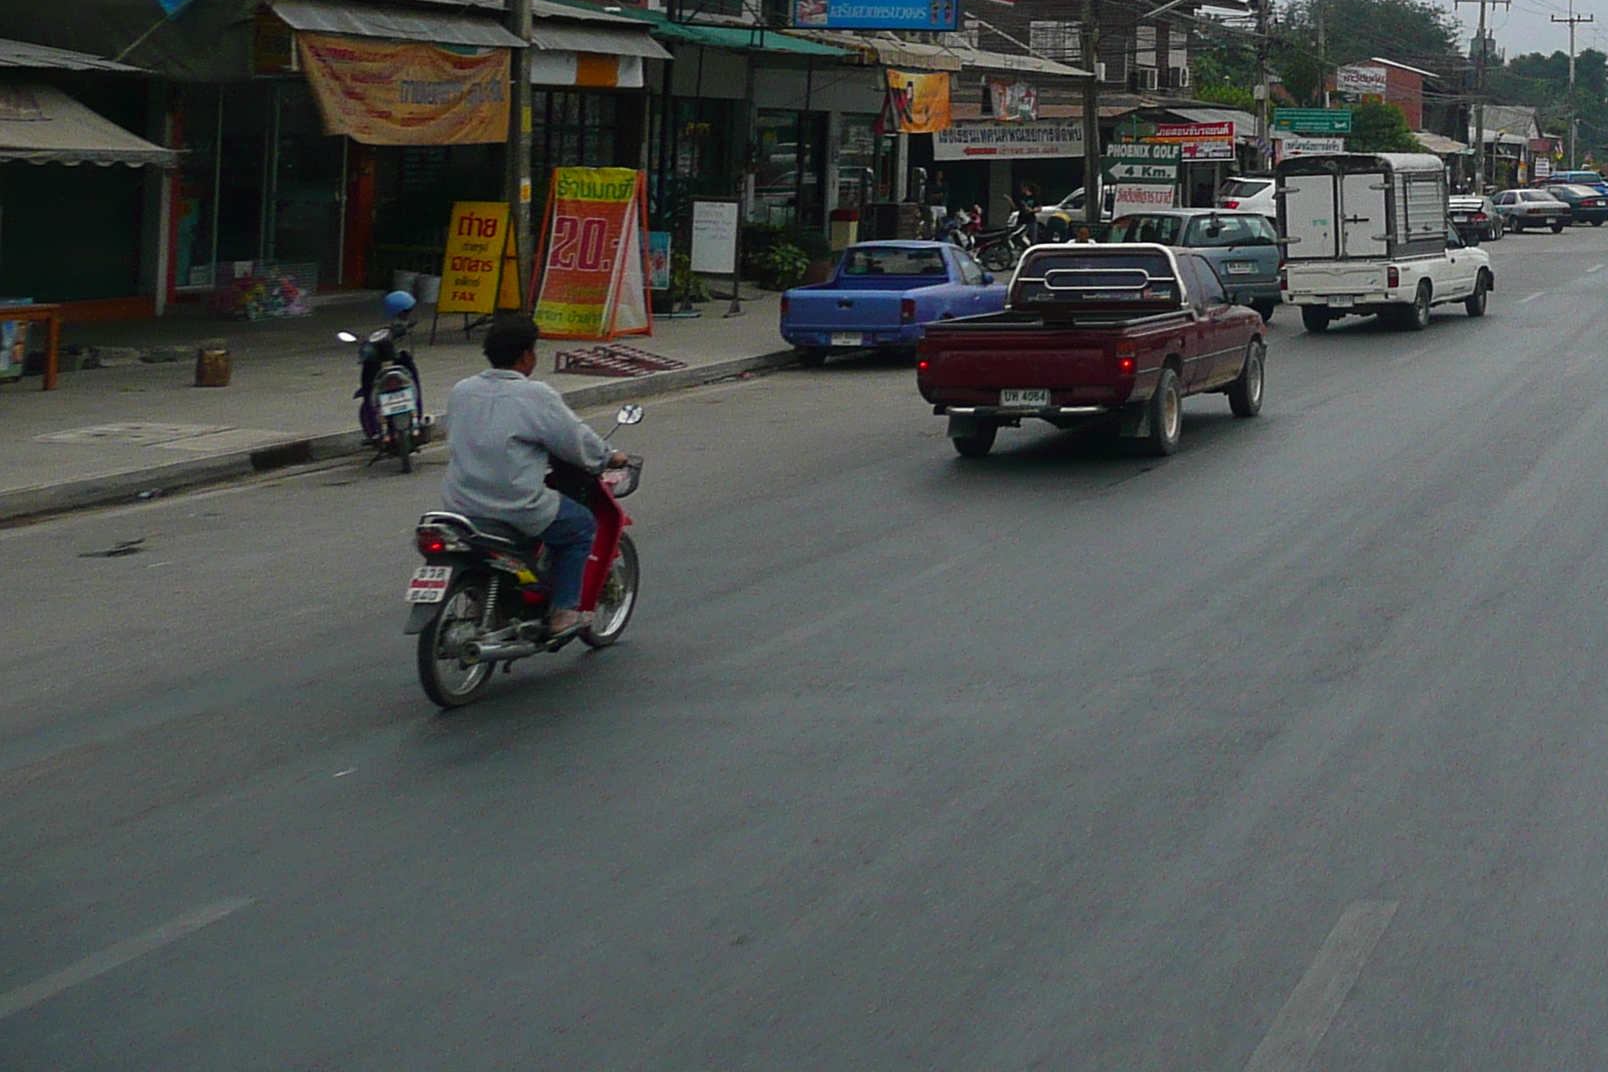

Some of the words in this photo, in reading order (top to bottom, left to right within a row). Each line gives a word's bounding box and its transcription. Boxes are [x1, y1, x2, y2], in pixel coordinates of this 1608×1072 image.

[1106, 143, 1150, 158] PHOENIX
[1153, 145, 1179, 159] GOLF
[1125, 167, 1135, 176] 4
[1141, 166, 1172, 177] Km.
[457, 211, 499, 238] ถ่าย
[450, 255, 494, 273] เอกสาร
[451, 290, 477, 303] FAX
